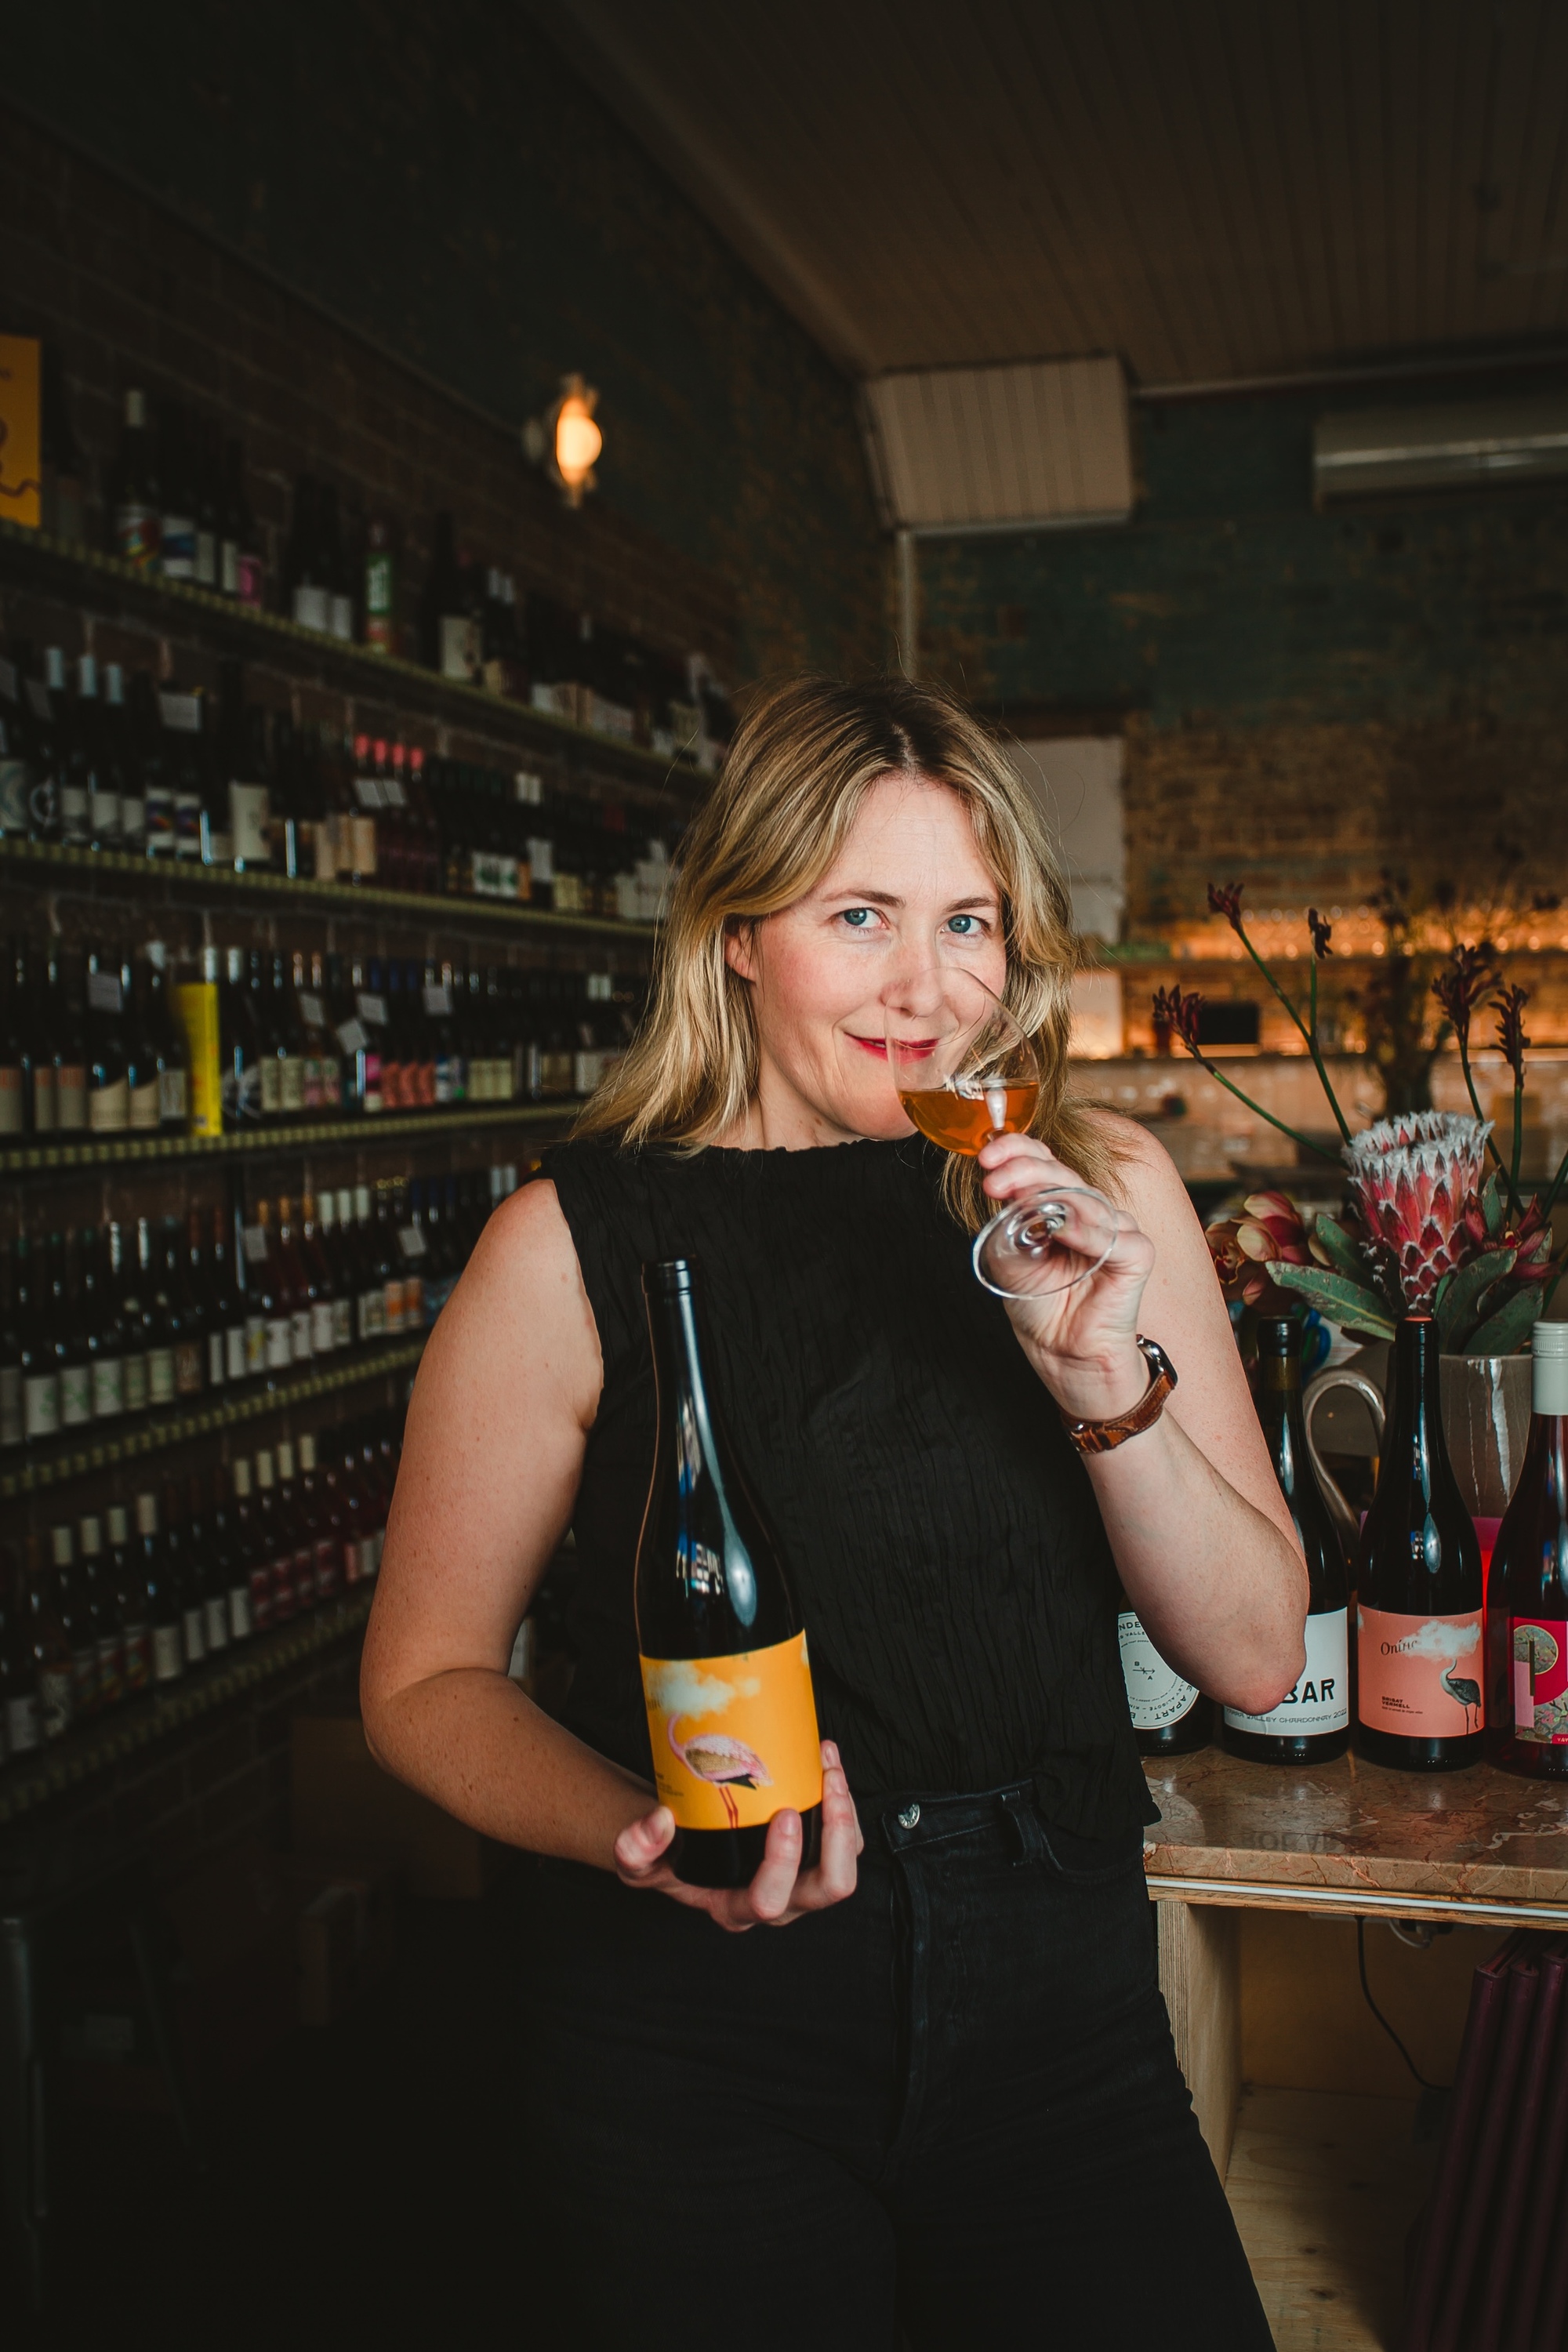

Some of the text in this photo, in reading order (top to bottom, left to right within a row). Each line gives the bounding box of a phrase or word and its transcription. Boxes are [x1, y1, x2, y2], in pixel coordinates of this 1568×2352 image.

[1118, 1621, 1141, 1631] NDE
[1155, 1695, 1186, 1720] APART
[1381, 1700, 1410, 1709] VERMELL
[1279, 1714, 1332, 1724] CHARDONNAY
